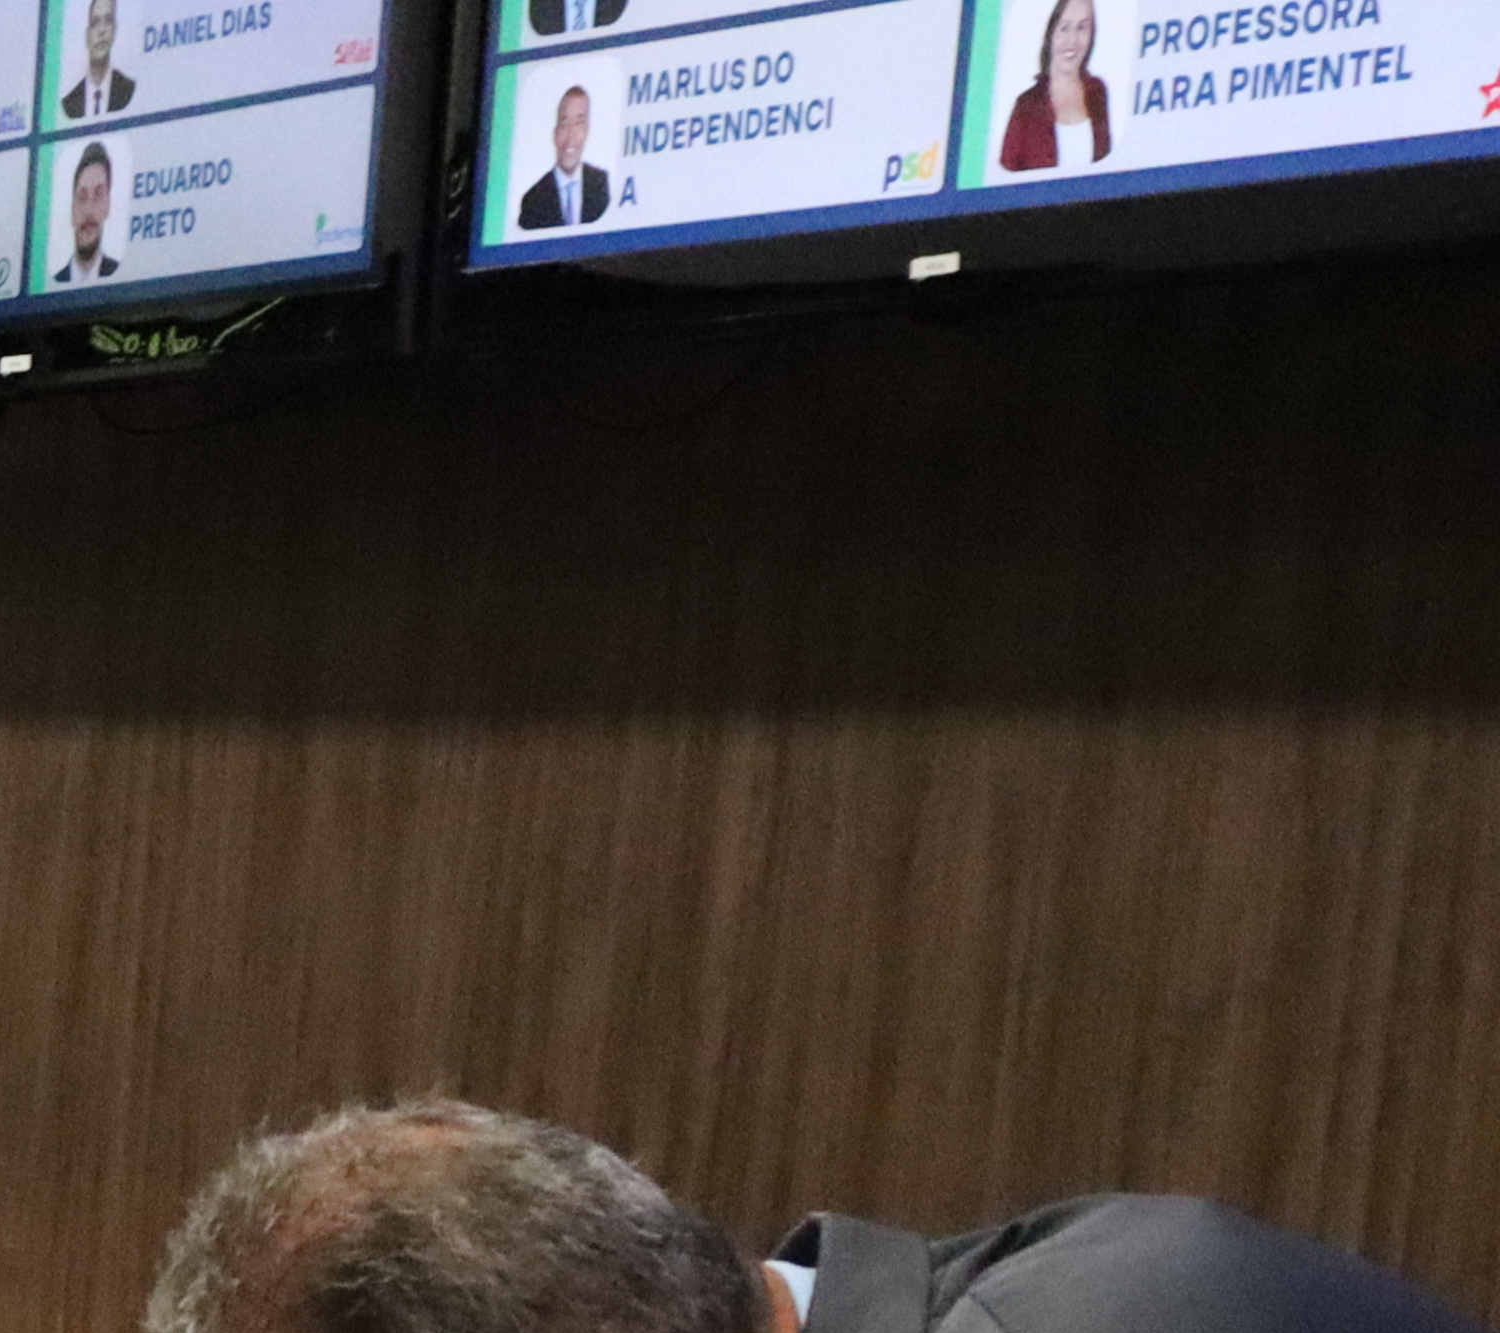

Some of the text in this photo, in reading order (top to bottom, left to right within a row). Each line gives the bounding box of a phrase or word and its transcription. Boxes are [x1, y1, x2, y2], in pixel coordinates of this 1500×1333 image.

[143, 1, 272, 54] DANIEL DIAS
[1138, 0, 1381, 59] PROFESSORA
[628, 50, 795, 107] MARLUS DO
[1133, 44, 1413, 116] IARA PIMENTEL
[622, 96, 835, 157] INDEPENDENCI
[133, 157, 233, 199] EDUARDO
[618, 175, 638, 208] A
[882, 140, 941, 193] psd
[129, 207, 196, 242] PRETO
